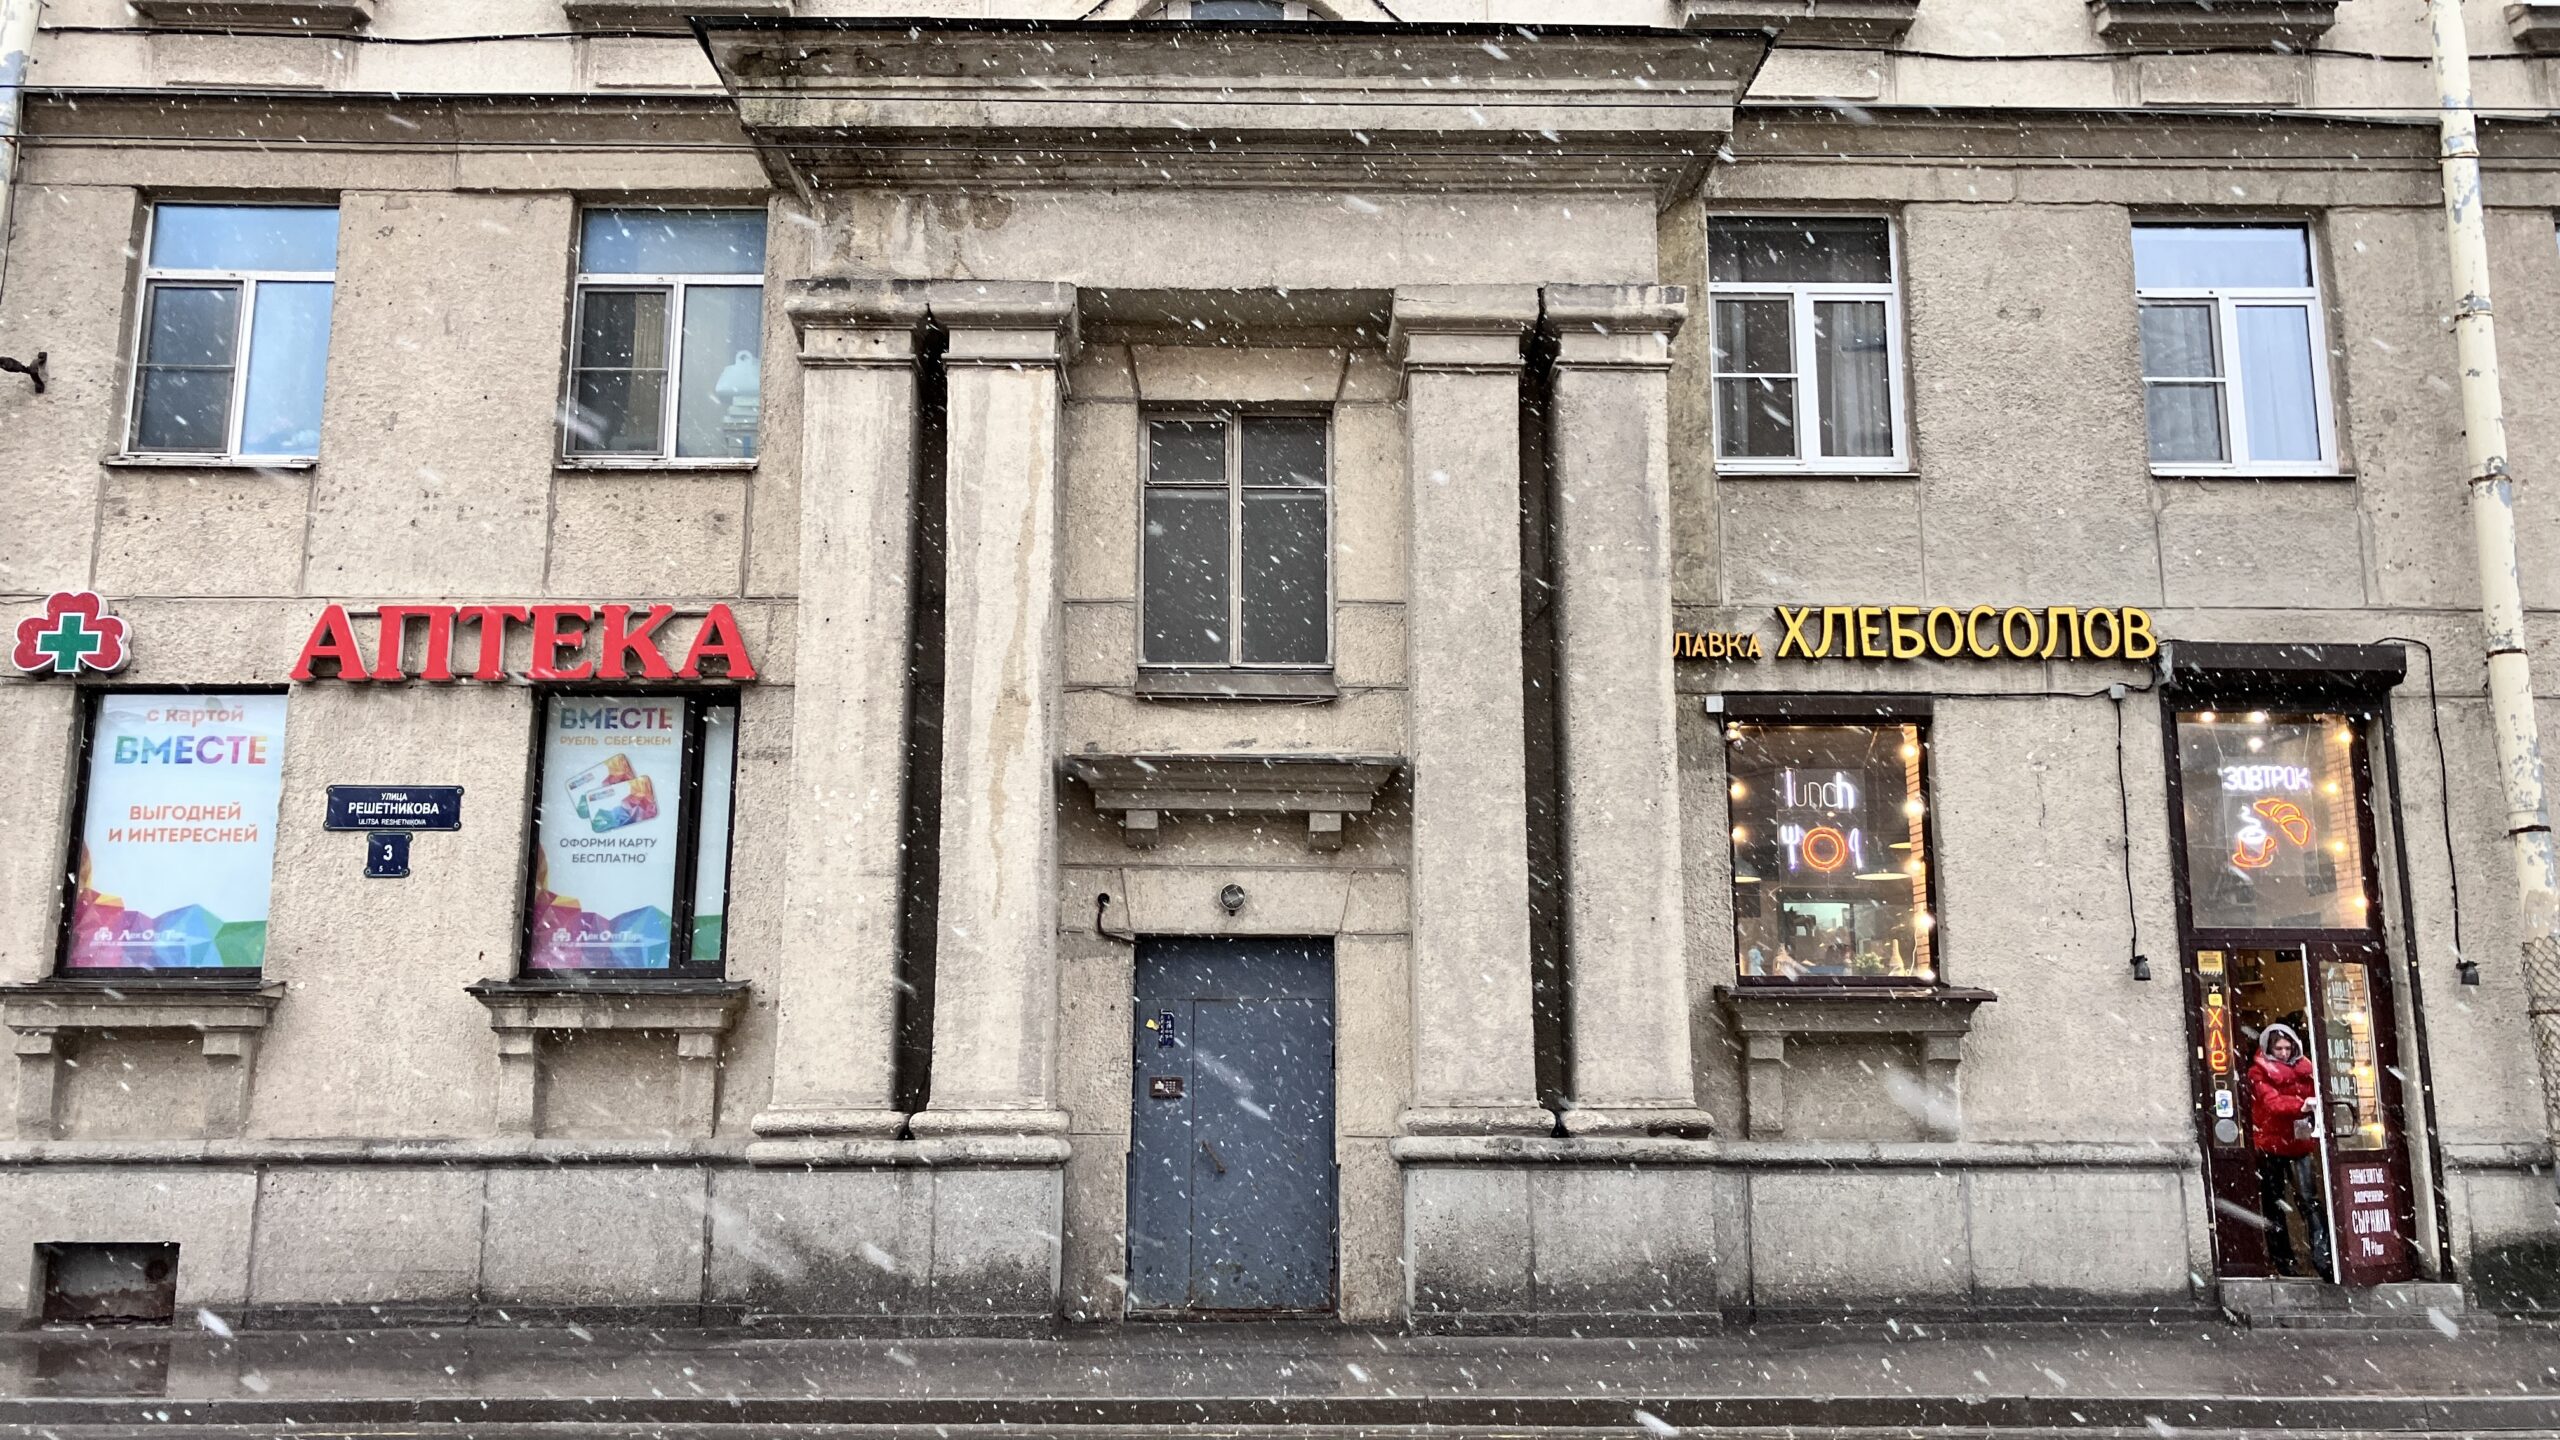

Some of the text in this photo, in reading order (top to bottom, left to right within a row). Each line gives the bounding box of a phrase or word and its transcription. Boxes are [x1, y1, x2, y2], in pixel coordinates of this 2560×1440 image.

[1673, 605, 2158, 660] ЛАВКА ХЛЕБОСОЛОВ
[290, 603, 758, 682] АПТЕКА
[166, 705, 244, 727] картой
[560, 708, 673, 729] ВМЕСТЕ
[114, 735, 269, 764] ВМЕСТЕ
[560, 736, 672, 746] РУБЛЬ СБЕРЕЖЕМ
[381, 792, 408, 802] УЛИЦА
[1785, 768, 1855, 810] lunch
[129, 802, 242, 821] ВЫГОДНЕЙ
[348, 802, 440, 815] РЕШЕТНИКОВА
[358, 818, 427, 827] ULITSA RESHETNIKOVA
[108, 824, 258, 842] И ИНТЕРЕСНЕЙ
[559, 838, 658, 848] ОФОРМИ КАРТУ
[383, 844, 393, 861] 3
[572, 853, 646, 863] БЕСПЛАТНО
[2352, 1209, 2391, 1234] СЫРНИКИ
